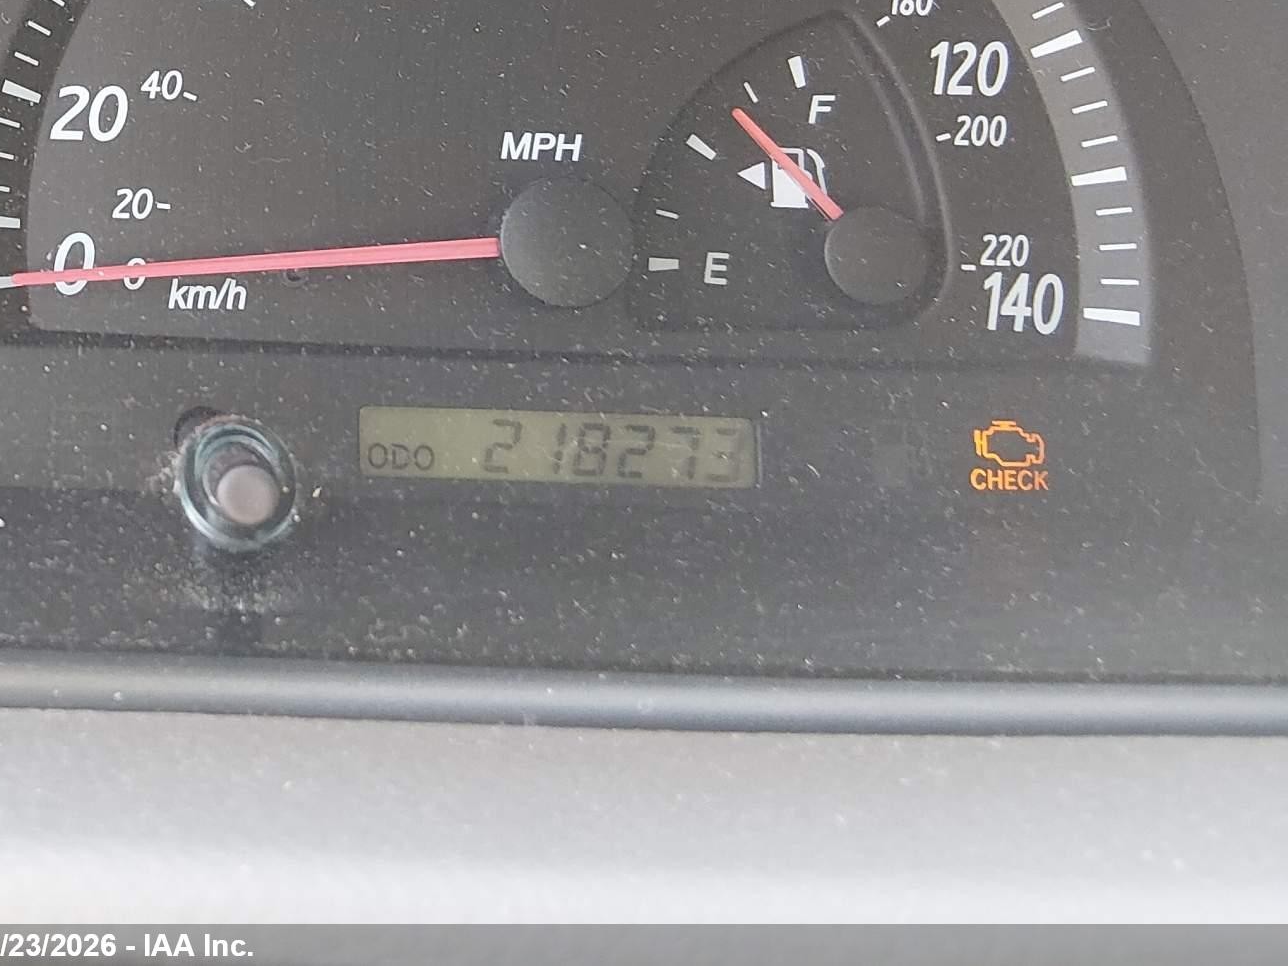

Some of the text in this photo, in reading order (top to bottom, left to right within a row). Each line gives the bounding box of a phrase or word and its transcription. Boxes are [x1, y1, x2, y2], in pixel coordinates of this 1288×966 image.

[930, 41, 1010, 97] 120
[141, 70, 183, 100] 40
[50, 85, 128, 141] 20
[809, 94, 836, 124] F
[954, 115, 1008, 146] 200
[500, 133, 582, 161] MPH
[112, 189, 154, 219] 20
[53, 232, 95, 296] 0
[979, 235, 1030, 266] 220
[704, 252, 729, 285] E
[168, 278, 247, 310] km/h
[983, 273, 1064, 334] 140
[367, 418, 743, 483] ODO 218273
[970, 469, 1050, 492] CHECK
